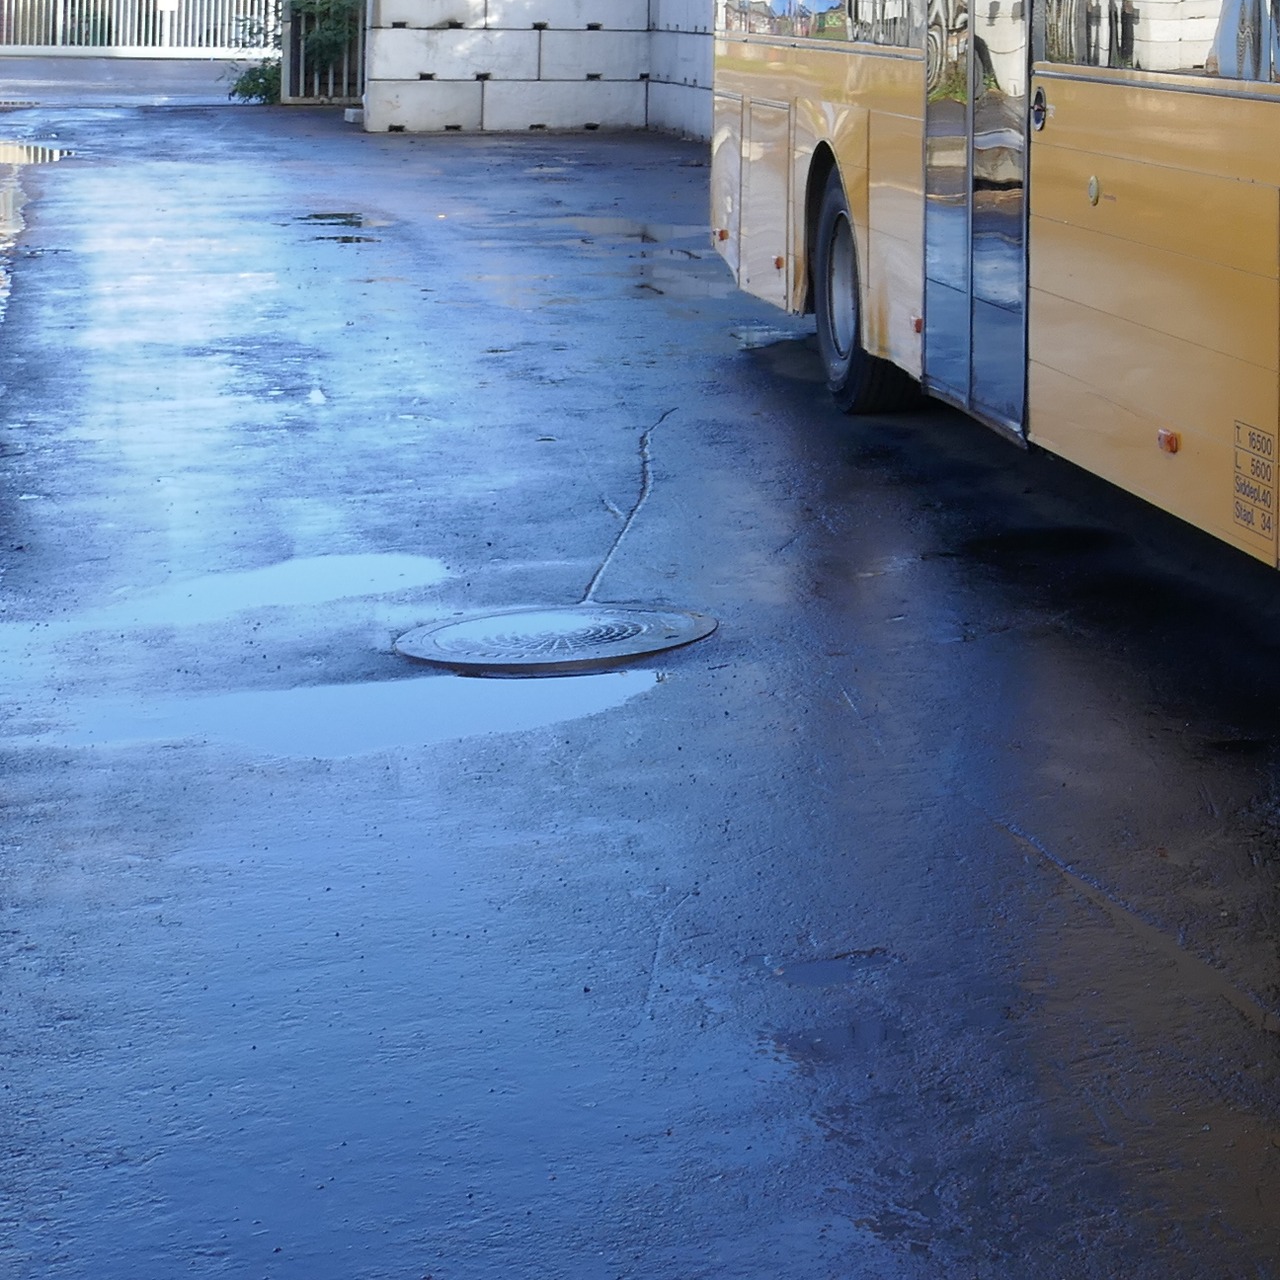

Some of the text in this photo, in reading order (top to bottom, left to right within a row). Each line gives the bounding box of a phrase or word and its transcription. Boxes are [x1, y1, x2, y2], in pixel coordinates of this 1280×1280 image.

[1248, 431, 1272, 456] 16500
[1250, 458, 1272, 482] 5600
[1261, 512, 1271, 533] 34
